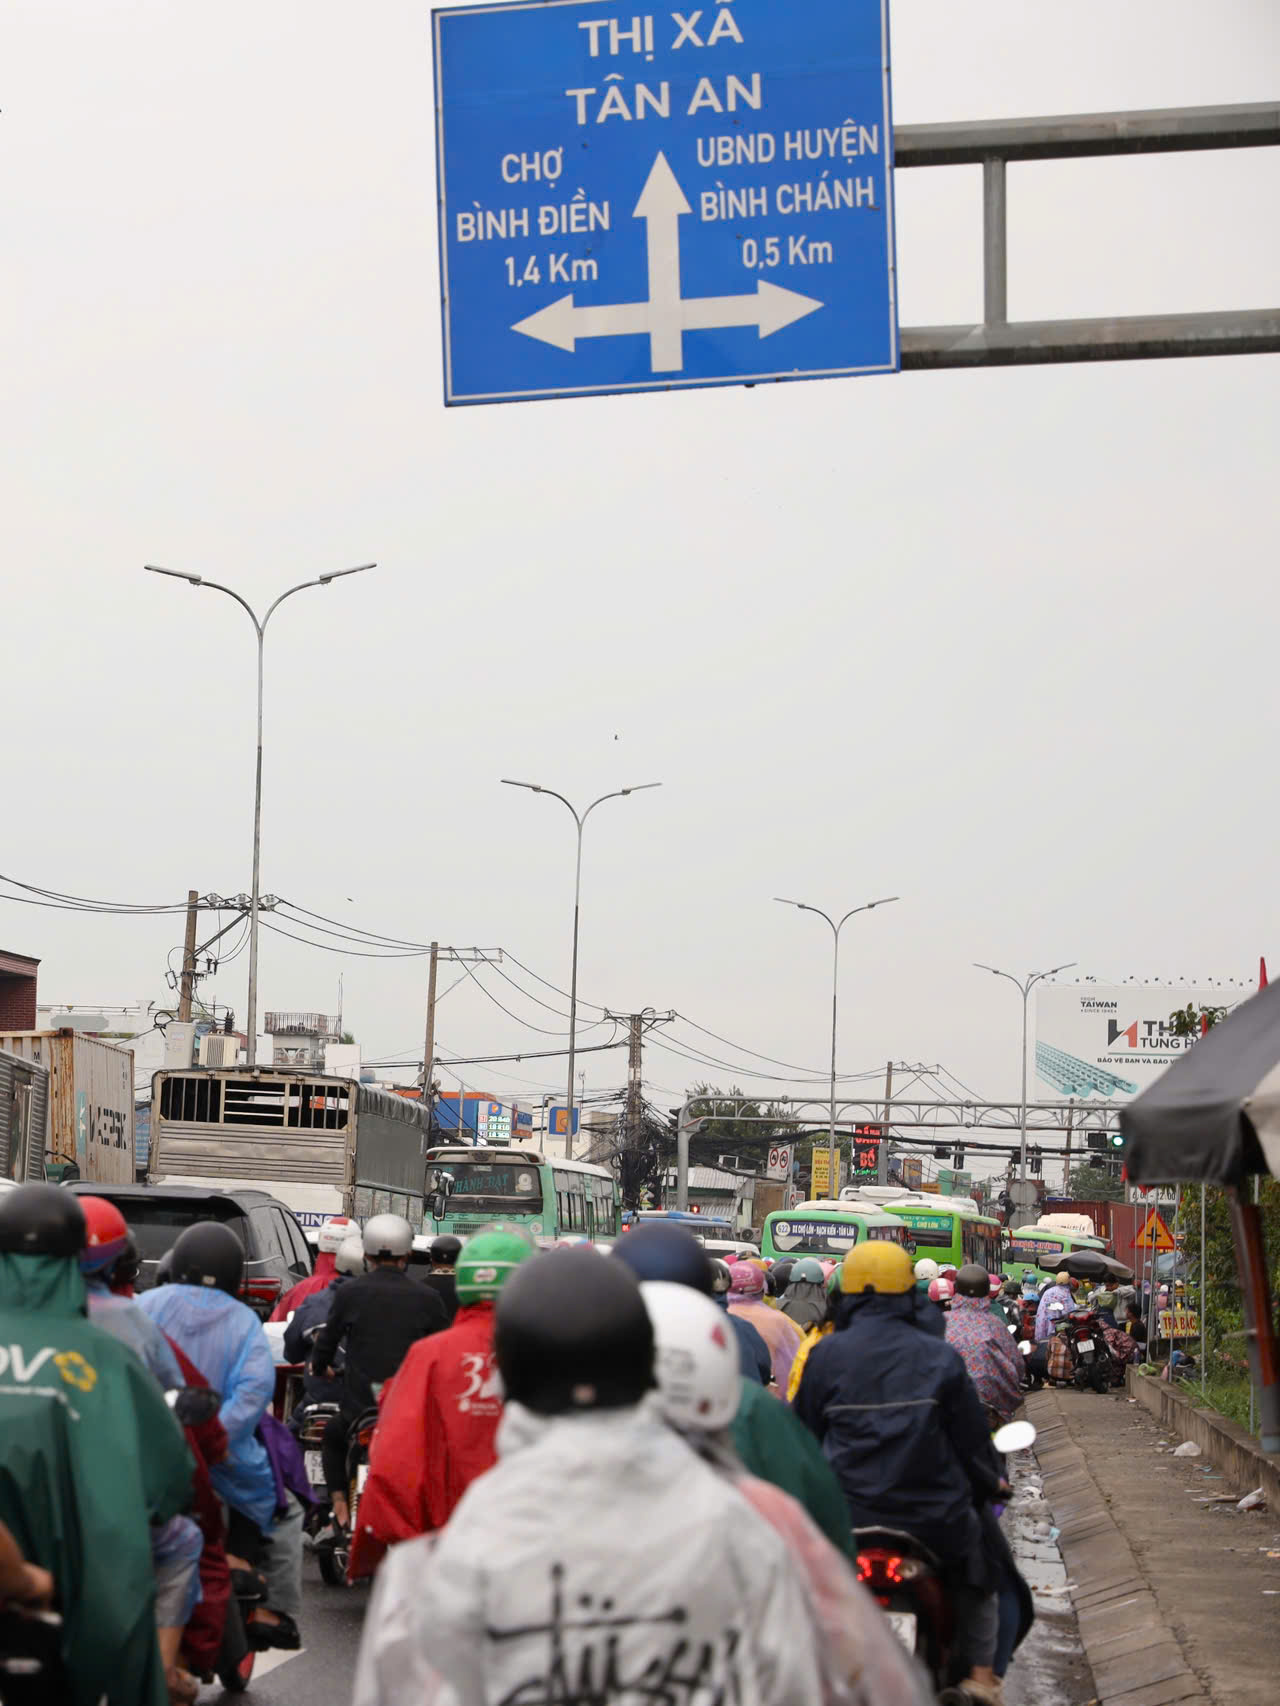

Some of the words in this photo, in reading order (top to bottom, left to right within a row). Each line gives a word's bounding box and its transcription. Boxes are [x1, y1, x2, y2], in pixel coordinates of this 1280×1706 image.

[578, 16, 655, 61] THỊ
[565, 73, 669, 125] TÂN
[687, 73, 762, 115] AN
[697, 133, 775, 167] UBND
[785, 118, 878, 164] HUYỆN
[501, 147, 563, 188] CHỢ
[457, 201, 529, 242] BÌNH
[538, 188, 610, 234] ĐIỀN
[701, 181, 767, 221] BÌNH
[776, 170, 874, 214] CHÁNH
[505, 256, 540, 287] 1,4
[549, 253, 598, 282] Km
[742, 239, 779, 270] 0,5
[789, 235, 833, 265] Km
[1081, 1001, 1118, 1009] TAIWAN
[1140, 1038, 1180, 1048] TUNG
